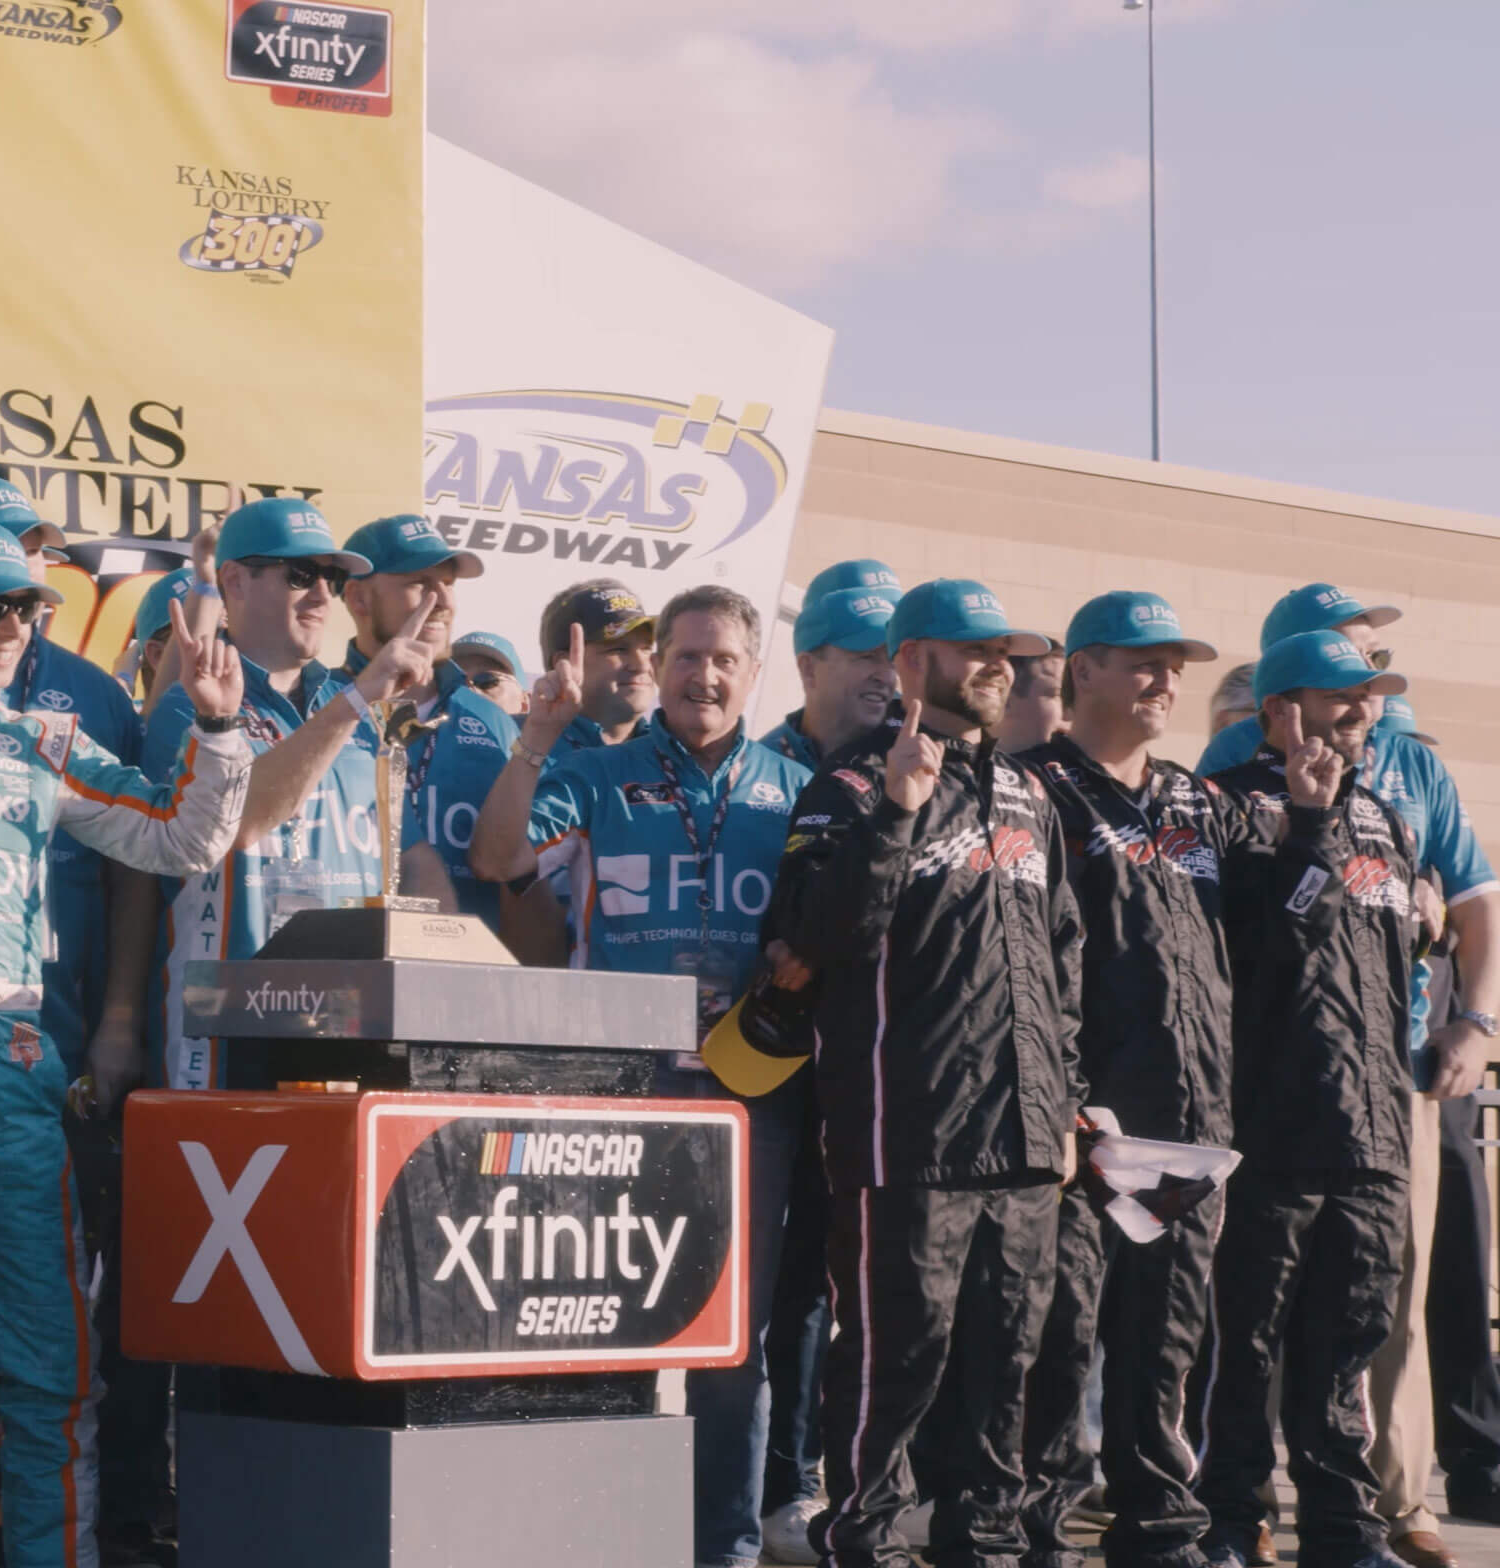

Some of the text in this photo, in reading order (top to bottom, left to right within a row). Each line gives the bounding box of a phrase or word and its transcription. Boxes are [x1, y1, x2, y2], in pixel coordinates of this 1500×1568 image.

[291, 8, 347, 30] NASCAR
[254, 25, 367, 77] xfinity
[289, 64, 336, 83] SERIES
[295, 90, 369, 113] PLAYOFFS
[175, 165, 293, 197] KANSAS
[193, 188, 331, 220] LOTTERY
[201, 217, 298, 267] 300
[425, 429, 698, 533] ANSAS
[432, 514, 693, 571] EEDWAY
[455, 735, 499, 749] TOYOTA
[668, 852, 774, 917] Flo
[245, 981, 326, 1019] xfinity
[520, 1133, 644, 1177] NASCAR
[433, 1186, 688, 1312] xfinity
[516, 1296, 621, 1336] SERIES
